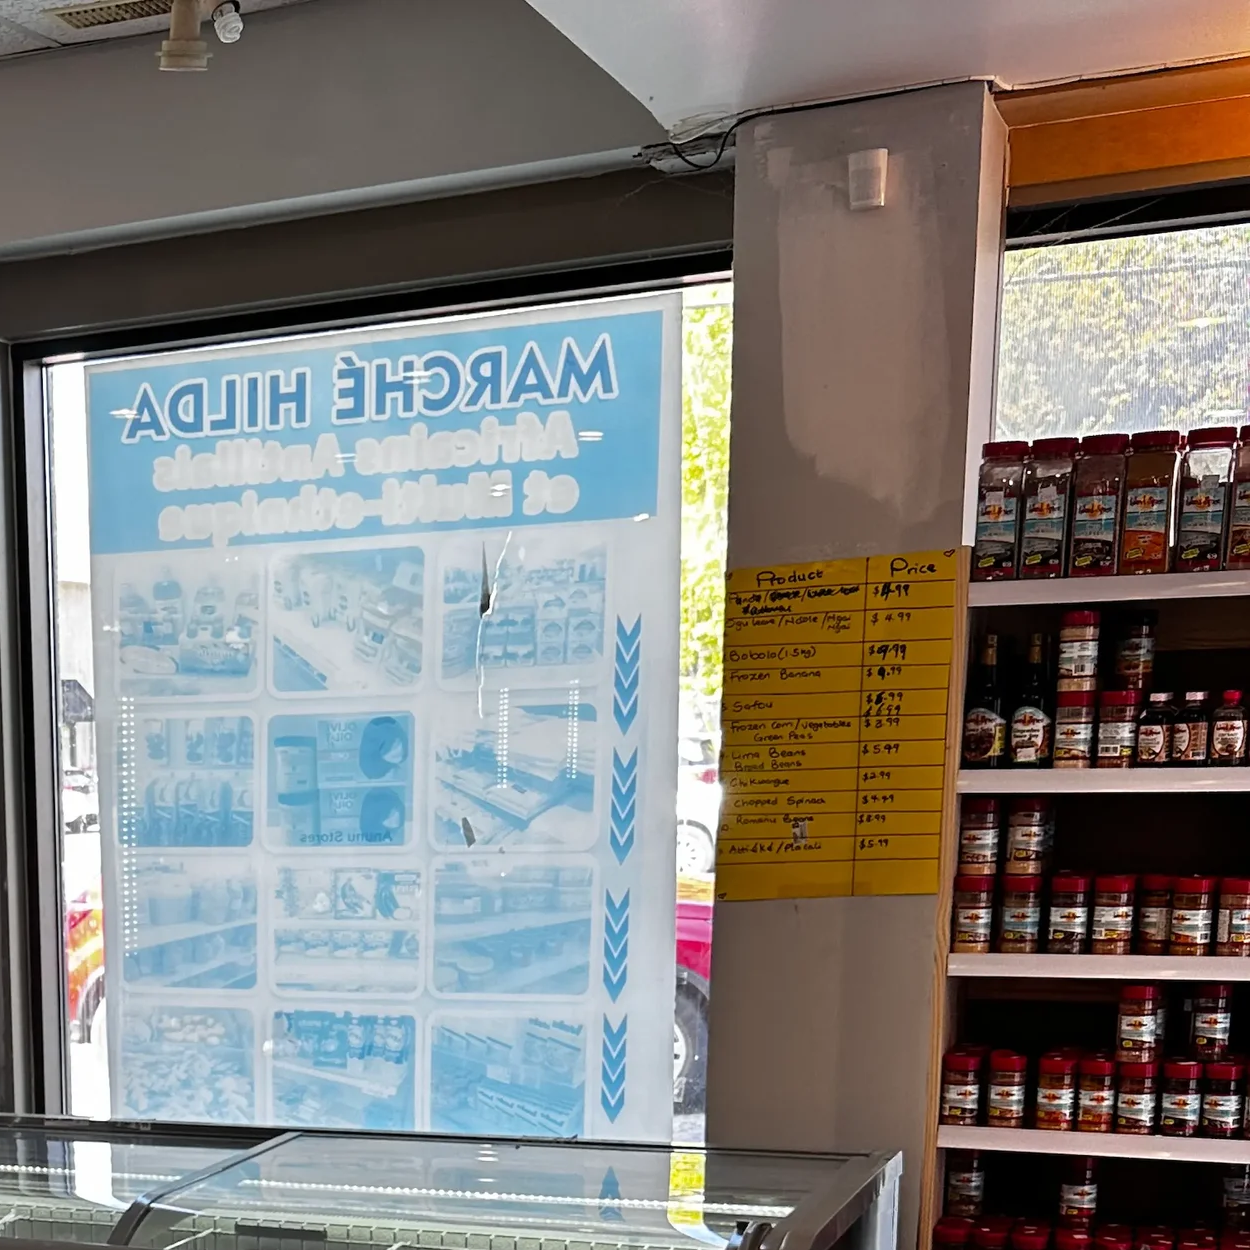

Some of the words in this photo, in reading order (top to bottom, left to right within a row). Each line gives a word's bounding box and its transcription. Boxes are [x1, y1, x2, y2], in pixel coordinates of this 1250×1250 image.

[890, 557, 937, 578] Price
[756, 570, 823, 588] Product
[730, 670, 770, 682] Frozen
[779, 668, 822, 681] Banana
[730, 721, 767, 734] Frozen
[754, 732, 784, 743] Green
[768, 747, 807, 759] Beans
[771, 759, 803, 770] Beans
[733, 797, 779, 808] Chopped
